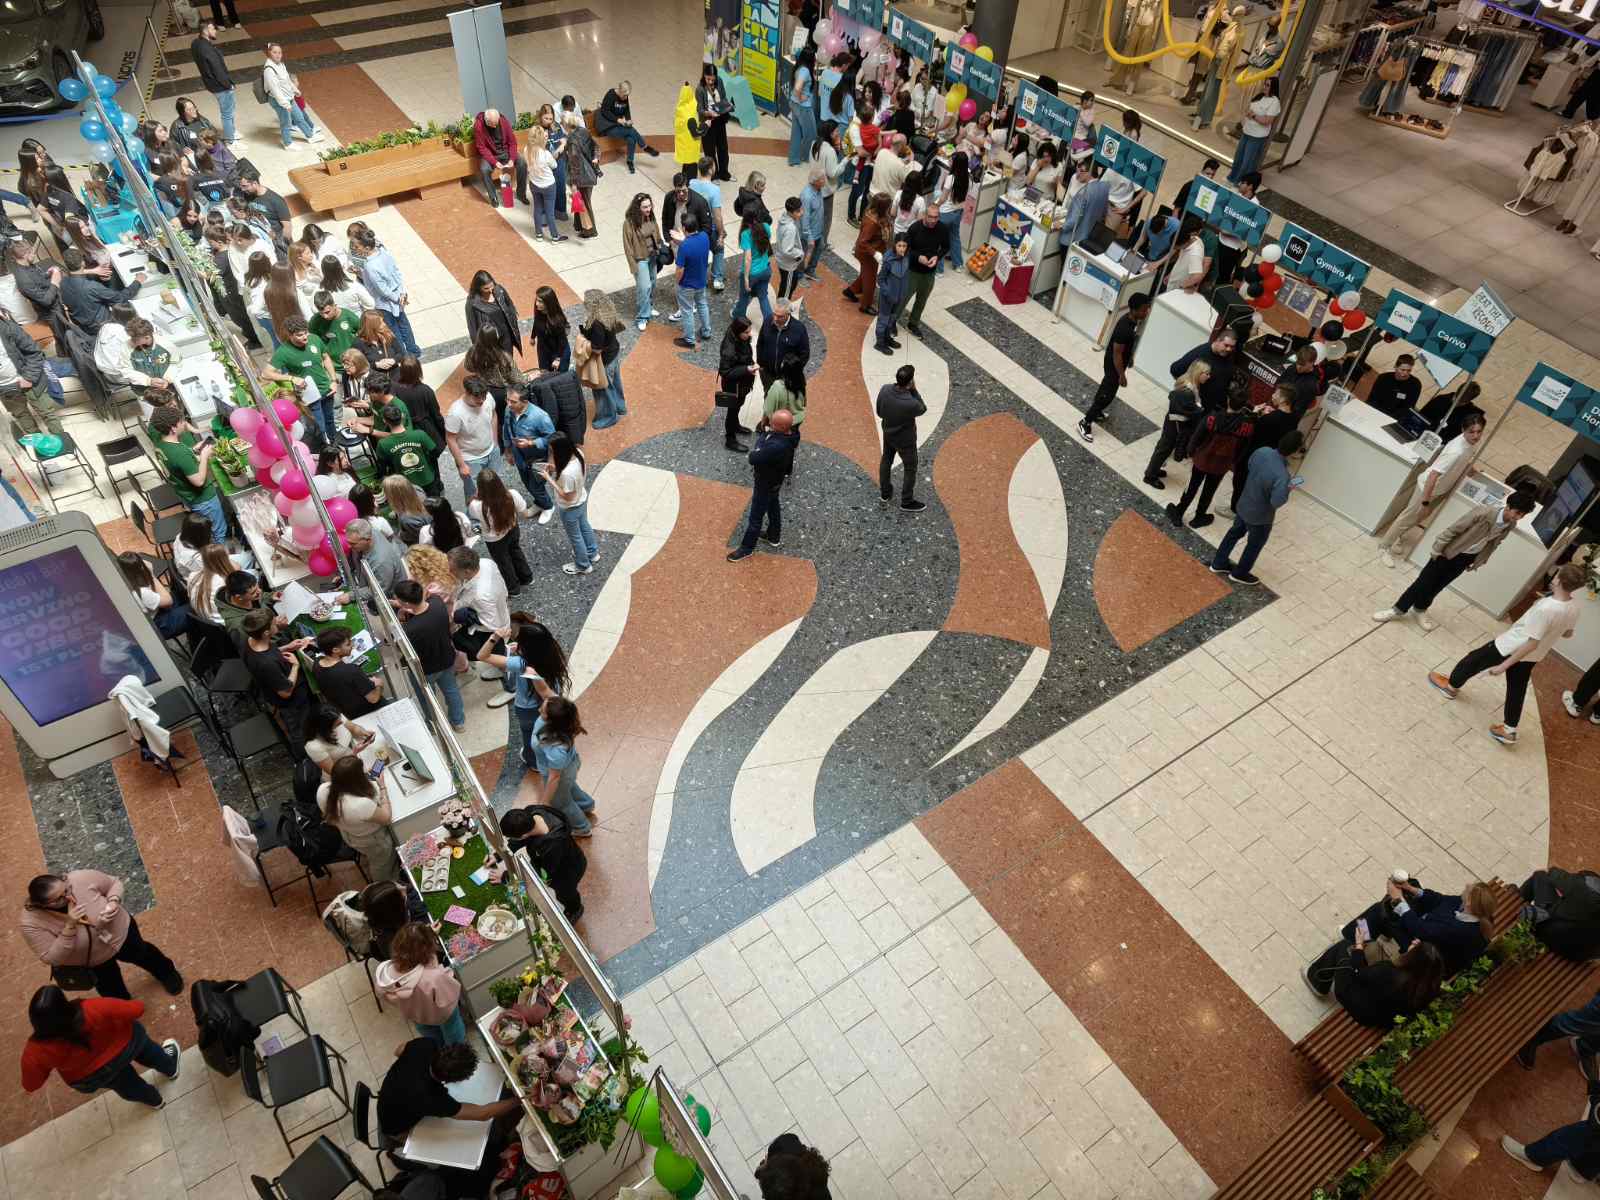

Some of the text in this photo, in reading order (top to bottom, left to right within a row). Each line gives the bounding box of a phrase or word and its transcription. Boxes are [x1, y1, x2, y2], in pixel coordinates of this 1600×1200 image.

[1315, 256, 1345, 277] Gymbro
[1437, 330, 1467, 349] Carivo
[1247, 360, 1278, 385] GYMBRO
